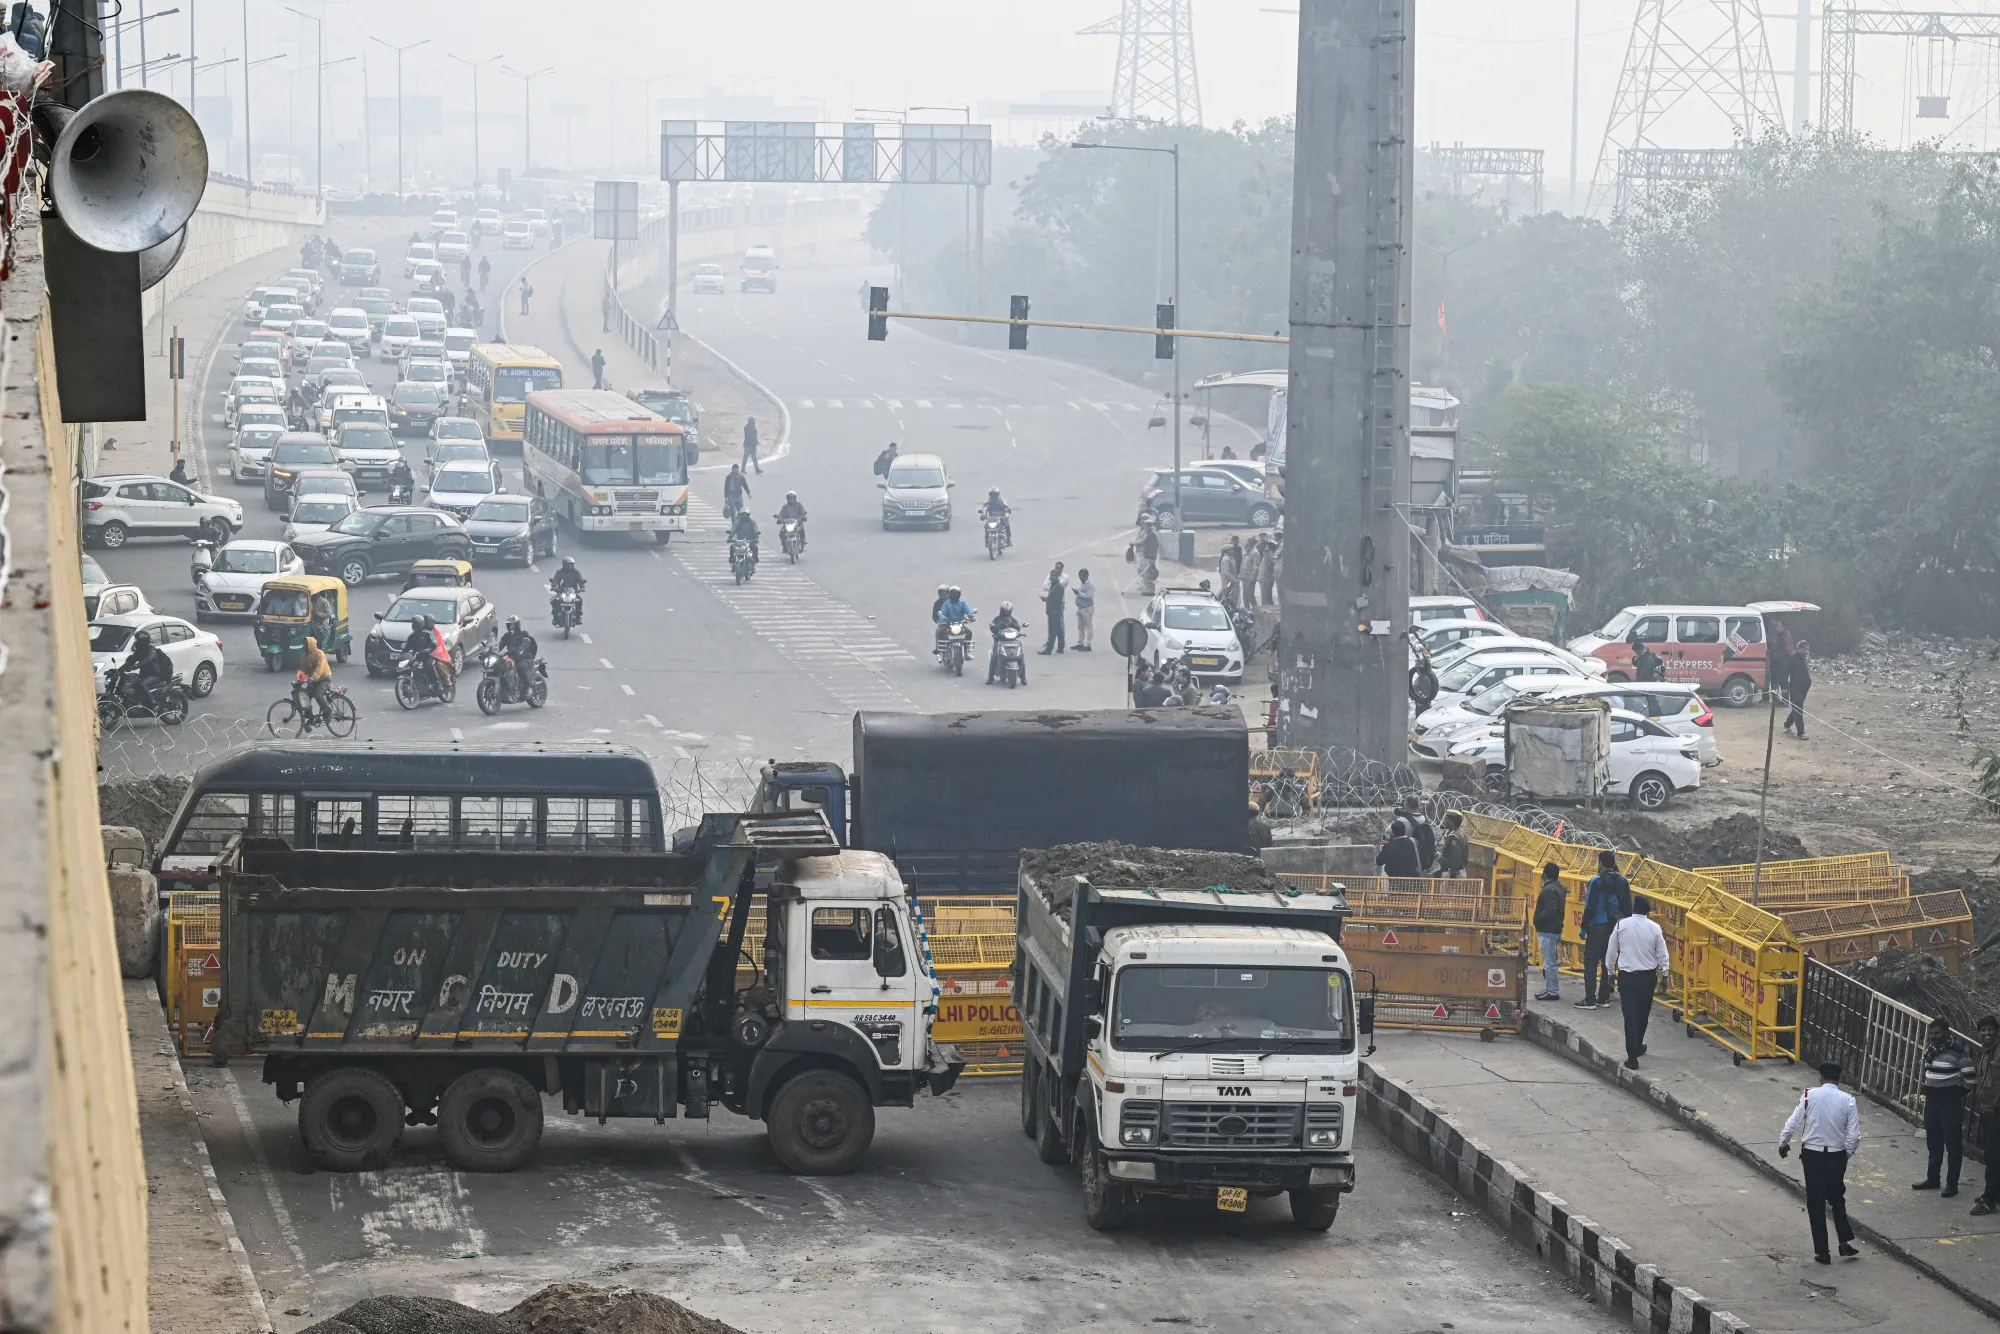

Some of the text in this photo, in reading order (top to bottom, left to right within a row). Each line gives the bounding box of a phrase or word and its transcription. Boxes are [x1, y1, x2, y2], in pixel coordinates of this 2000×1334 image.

[532, 369, 556, 377] SCHOOL
[1673, 660, 1713, 670] EXPRESS
[393, 947, 548, 969] ON DUTY
[322, 973, 358, 1014] M
[547, 973, 579, 1014] D
[1739, 970, 1755, 998] पुलि
[366, 989, 416, 1014] नगर
[476, 984, 533, 1015] निगम
[936, 1005, 962, 1022] LHI
[1216, 1086, 1252, 1097] TATA
